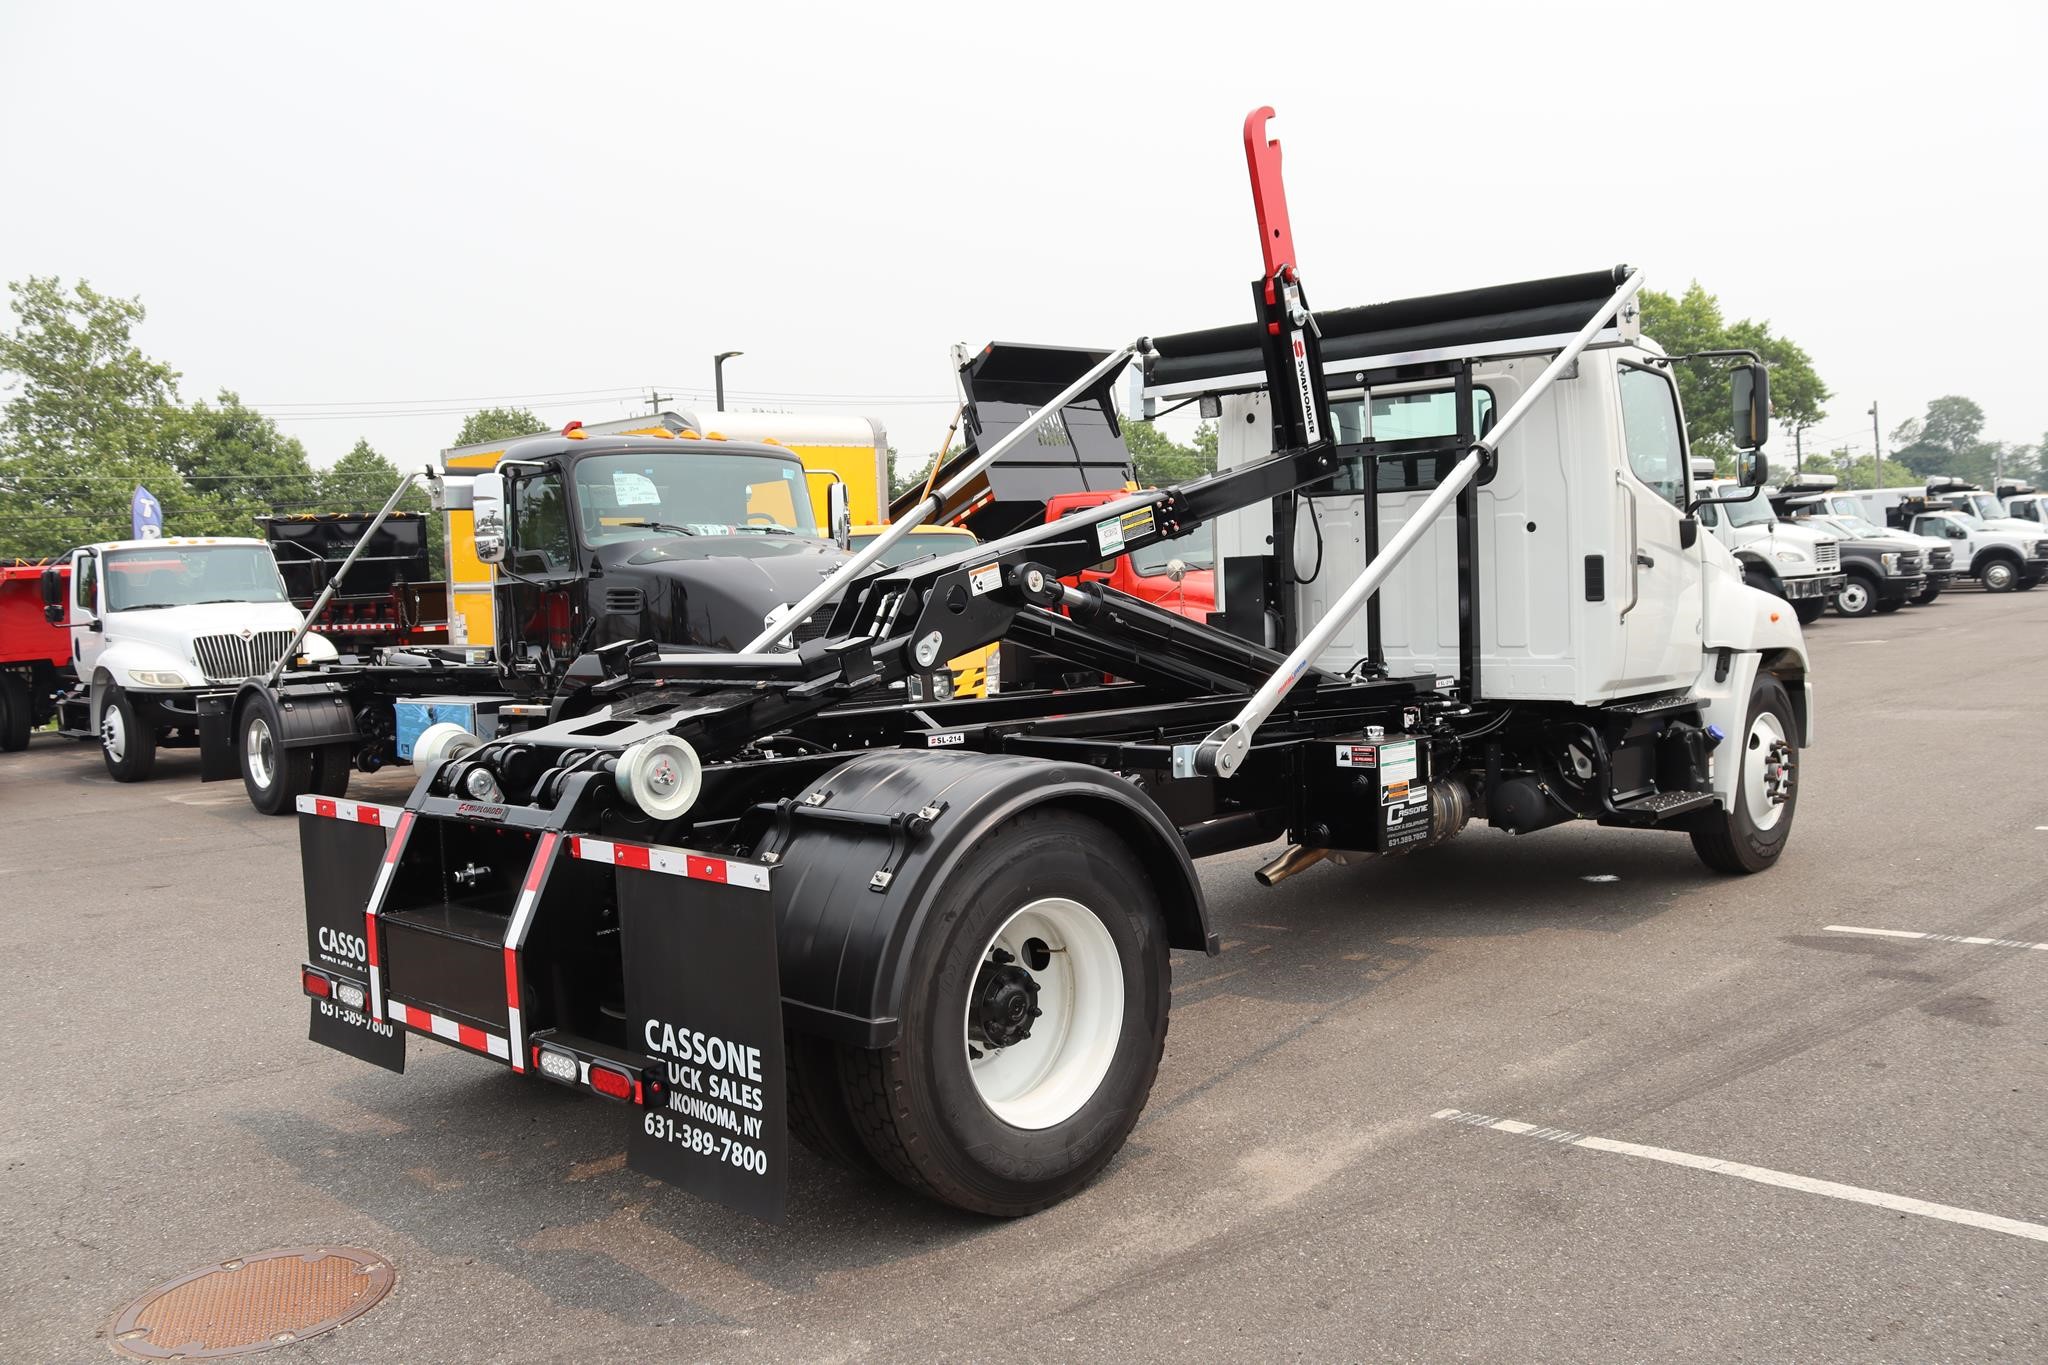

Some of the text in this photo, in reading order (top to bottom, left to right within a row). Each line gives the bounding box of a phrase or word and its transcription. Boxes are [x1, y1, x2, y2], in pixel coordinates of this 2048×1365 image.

[1298, 360, 1315, 434] SWAPLOADER
[937, 735, 961, 744] SL-214
[319, 927, 366, 962] CASSO
[645, 1019, 762, 1083] CASSONE
[646, 1055, 763, 1112] UCK SALES
[644, 1113, 767, 1175] 631-389-7800
[744, 1115, 763, 1139] NY
